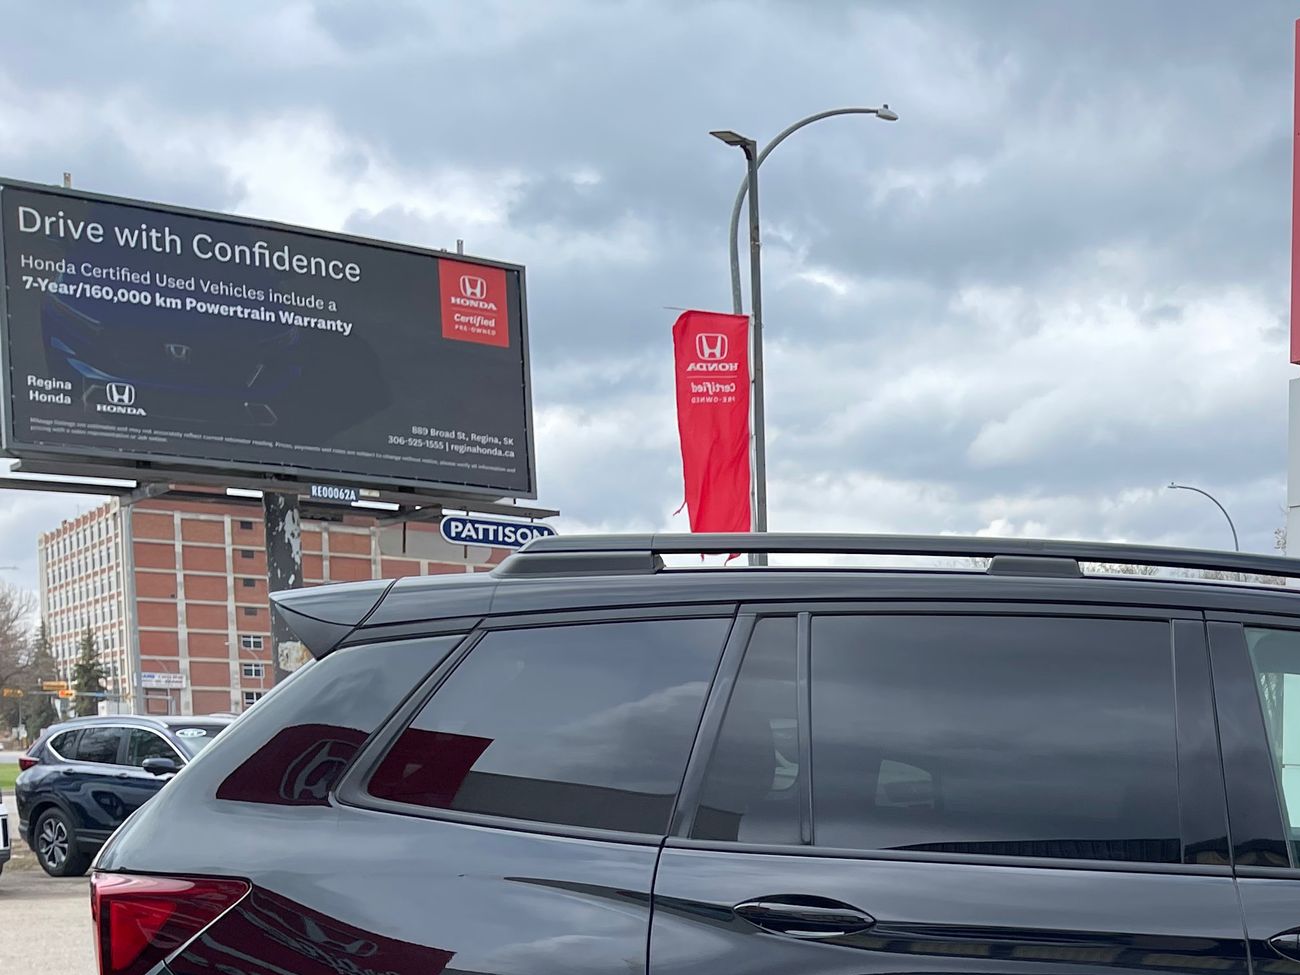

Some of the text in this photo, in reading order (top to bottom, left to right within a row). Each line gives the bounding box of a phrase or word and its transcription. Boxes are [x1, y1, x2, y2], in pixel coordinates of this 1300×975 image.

[18, 206, 361, 282] Drive with Confidence
[20, 254, 337, 312] Honda Certified Used Vehicles include a
[22, 276, 353, 336] 7-Year/160,000 km Powertrain Warranty
[450, 296, 497, 311] HONDA
[454, 313, 496, 328] Certified
[27, 375, 72, 390] Regina
[29, 390, 72, 404] Honda
[96, 404, 147, 416] HONDA
[430, 428, 455, 439] Broad
[471, 433, 501, 445] Regina,
[503, 437, 514, 445] SK
[451, 444, 515, 458] reginahonda.ca
[311, 485, 356, 501] RE00062A
